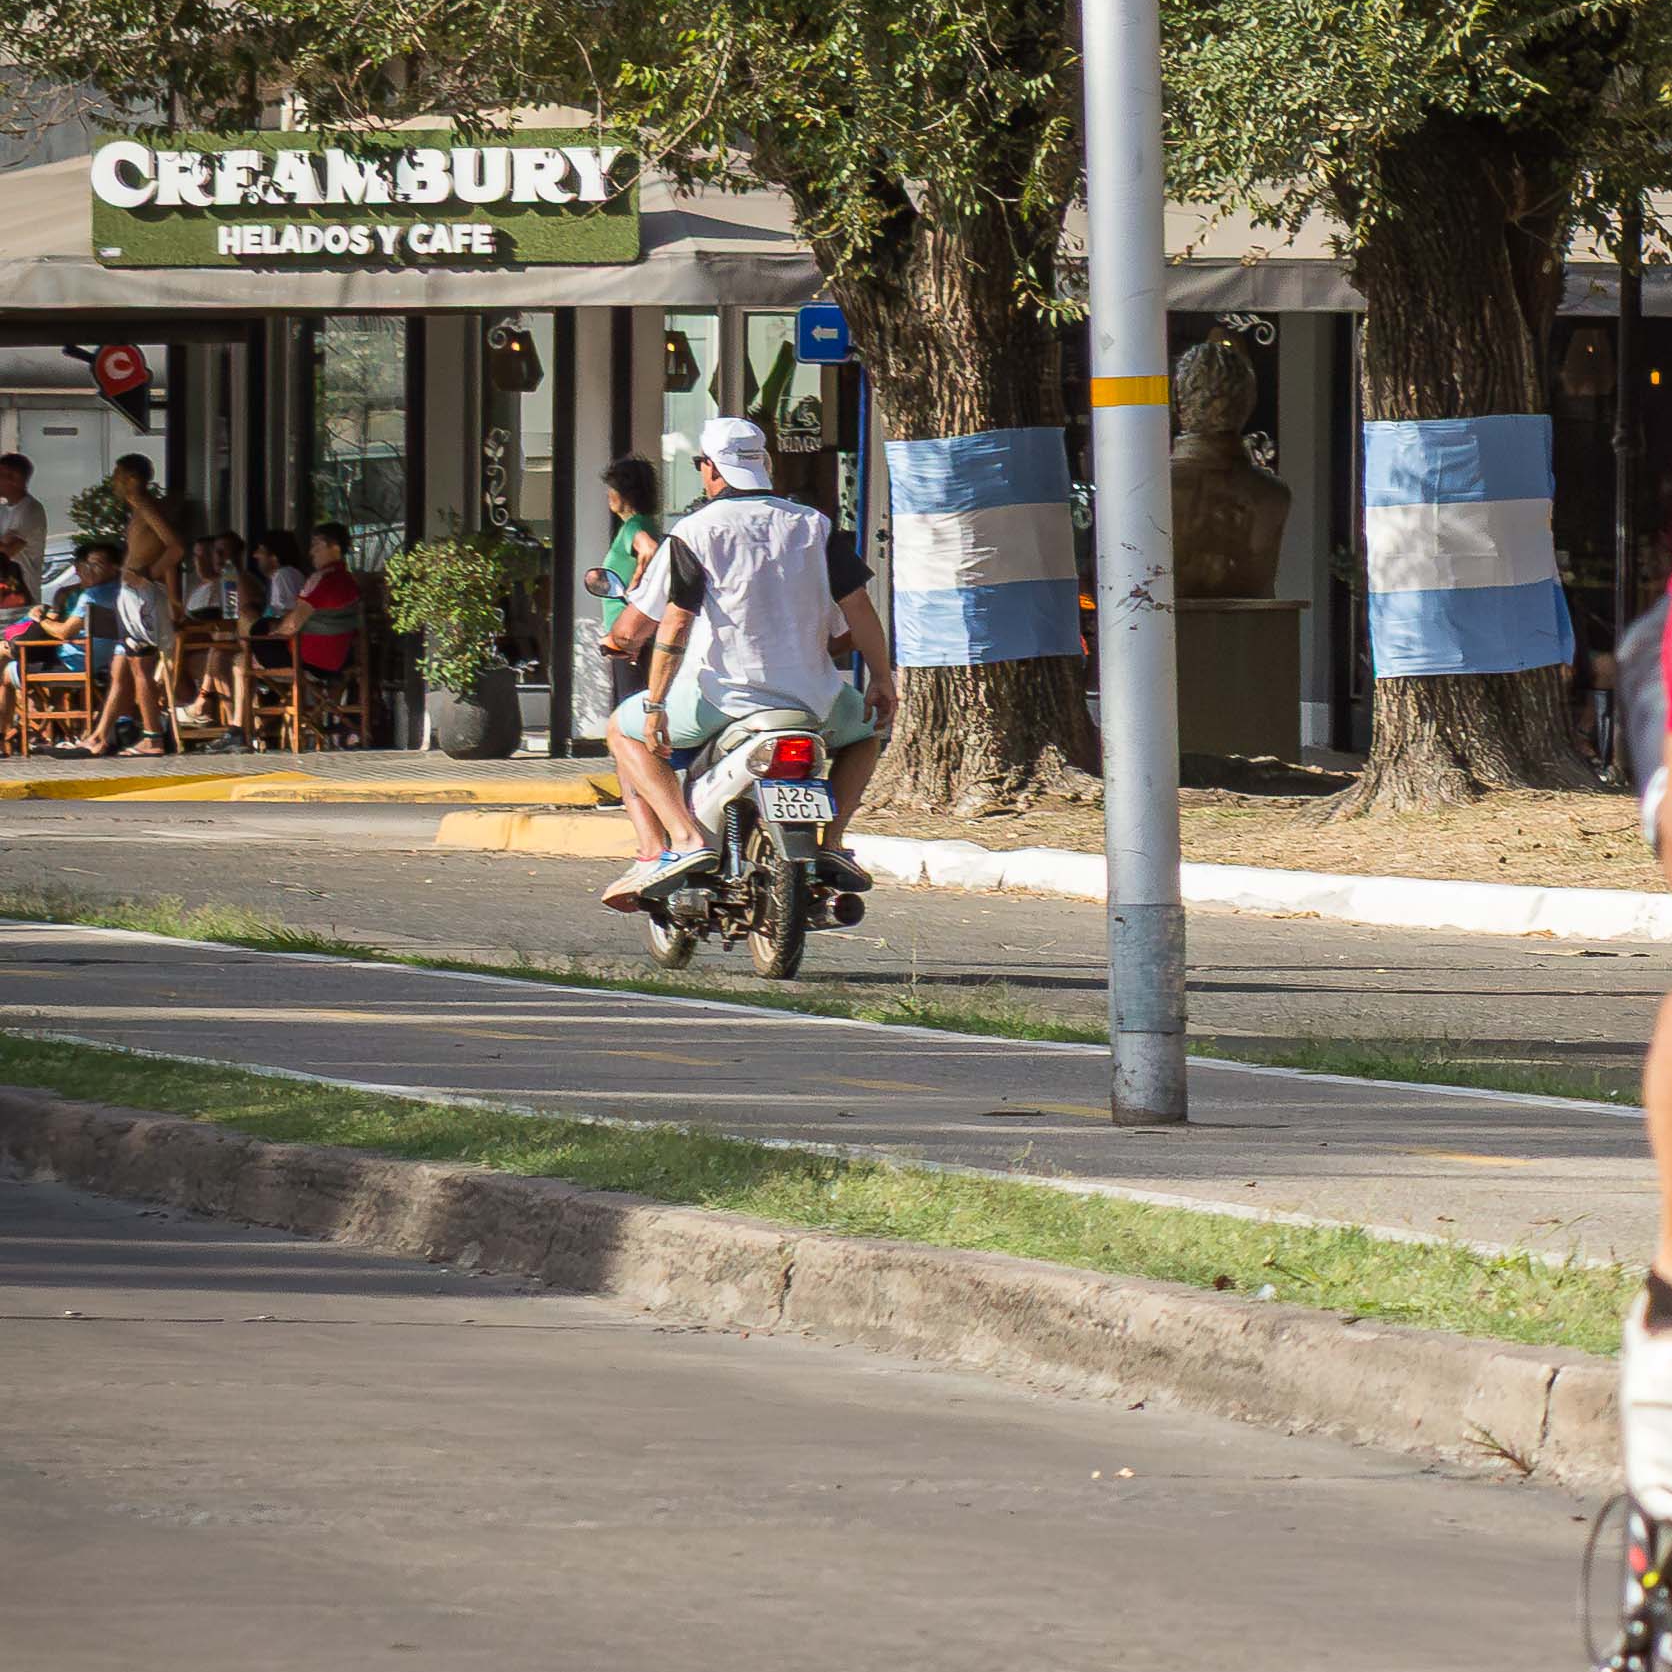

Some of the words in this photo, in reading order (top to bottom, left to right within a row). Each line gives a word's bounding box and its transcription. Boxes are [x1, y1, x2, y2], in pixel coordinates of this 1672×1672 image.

[90, 139, 624, 209] CREAMBURY
[216, 224, 371, 256] HELADOS
[374, 224, 396, 256] Y
[407, 223, 495, 255] CAFE
[776, 787, 815, 803] A26
